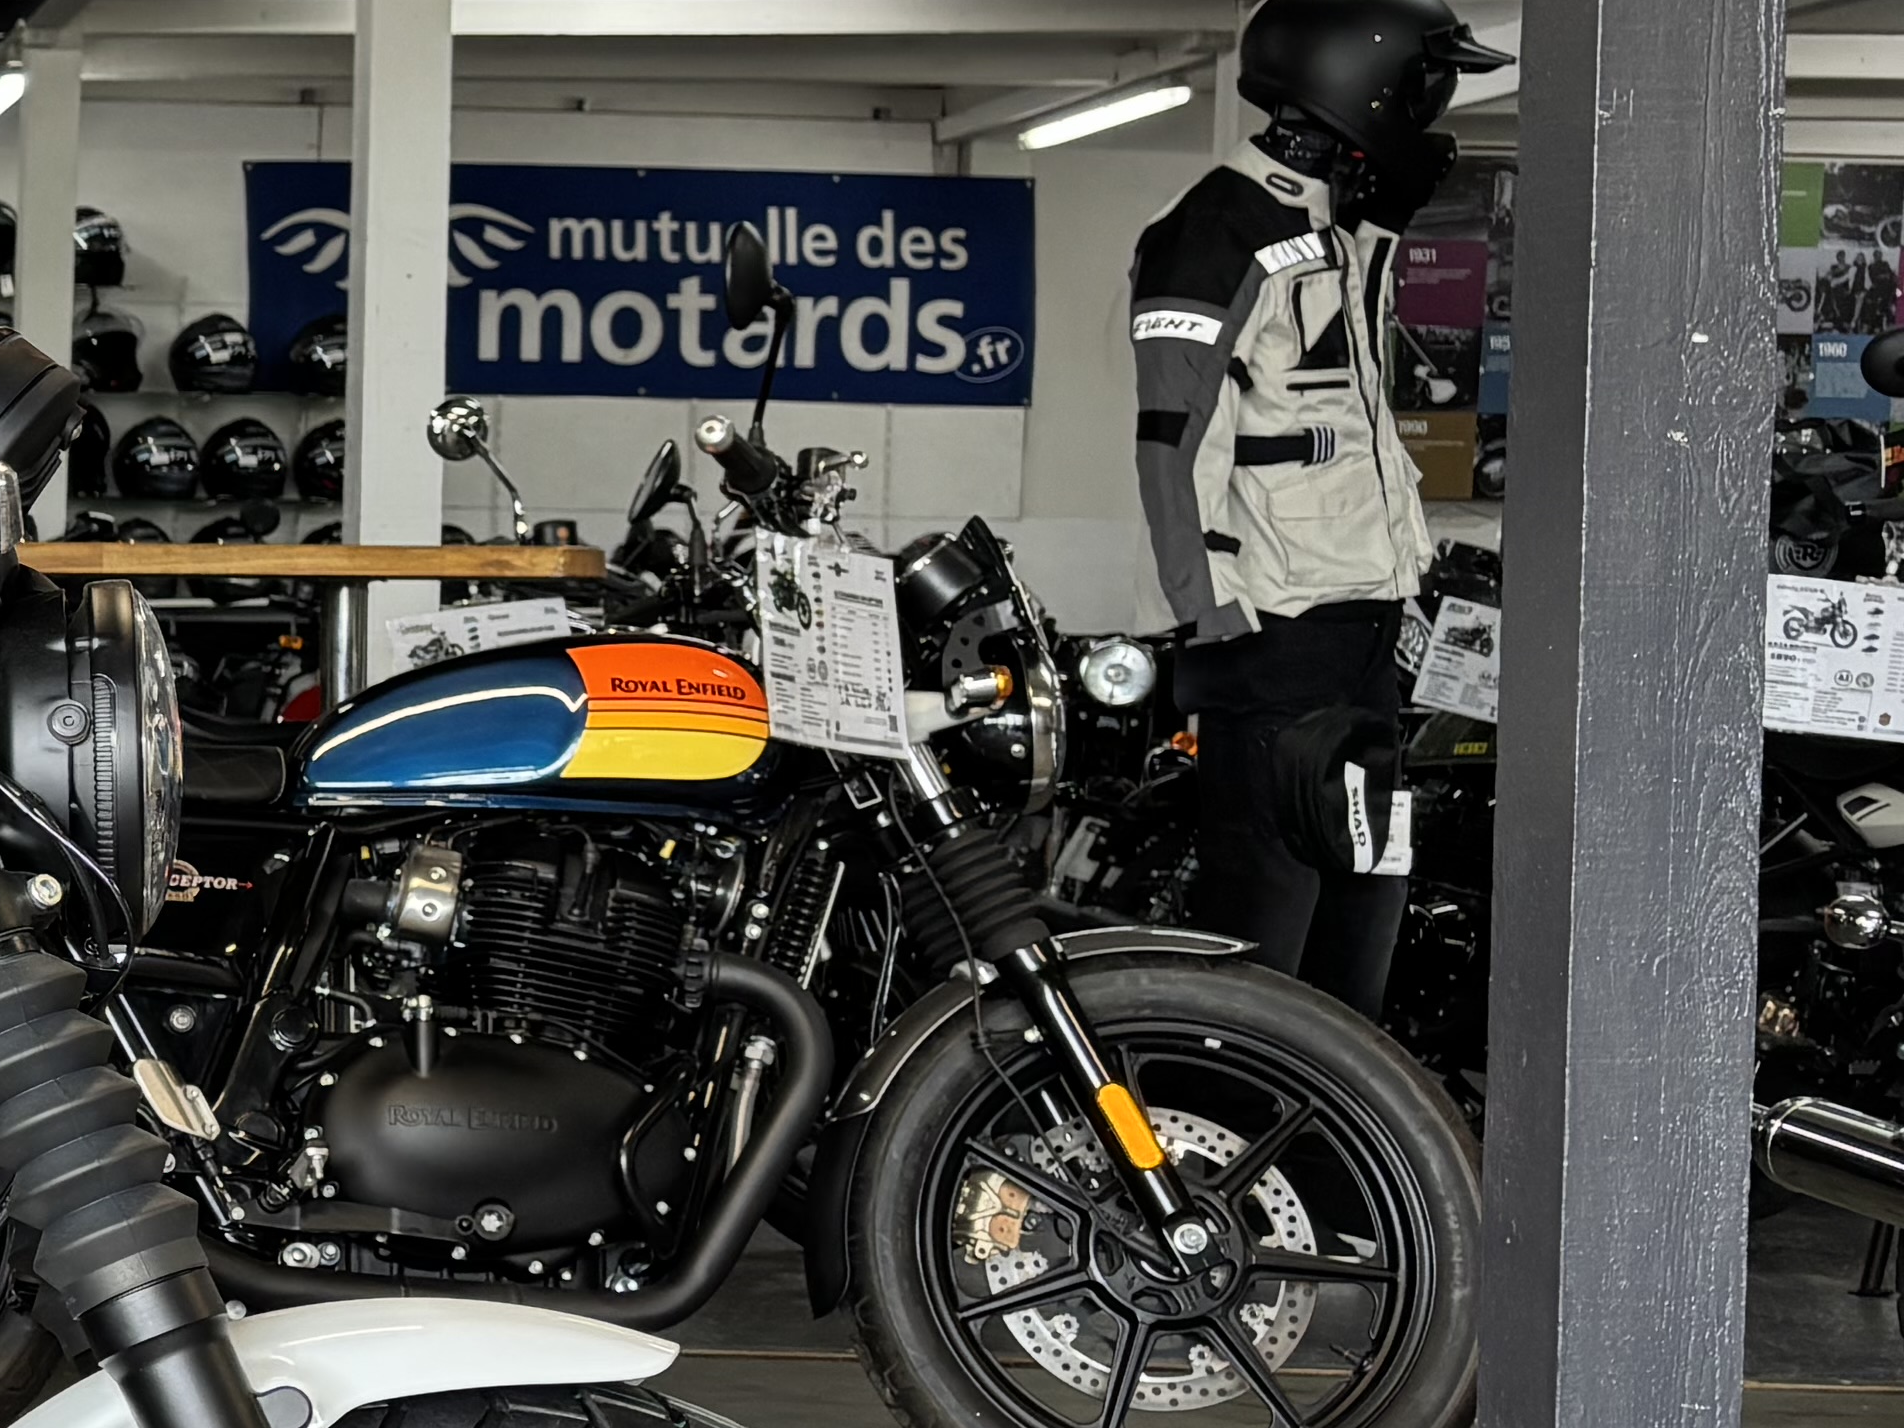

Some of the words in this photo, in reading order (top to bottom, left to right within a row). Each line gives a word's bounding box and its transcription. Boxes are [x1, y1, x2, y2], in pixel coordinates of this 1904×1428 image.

[547, 205, 838, 268] mutulle
[857, 209, 969, 271] des
[610, 676, 672, 696] ROYAL
[674, 678, 747, 701] ENFIELD
[168, 874, 238, 890] CEPTOR
[388, 1105, 463, 1128] ROYAL
